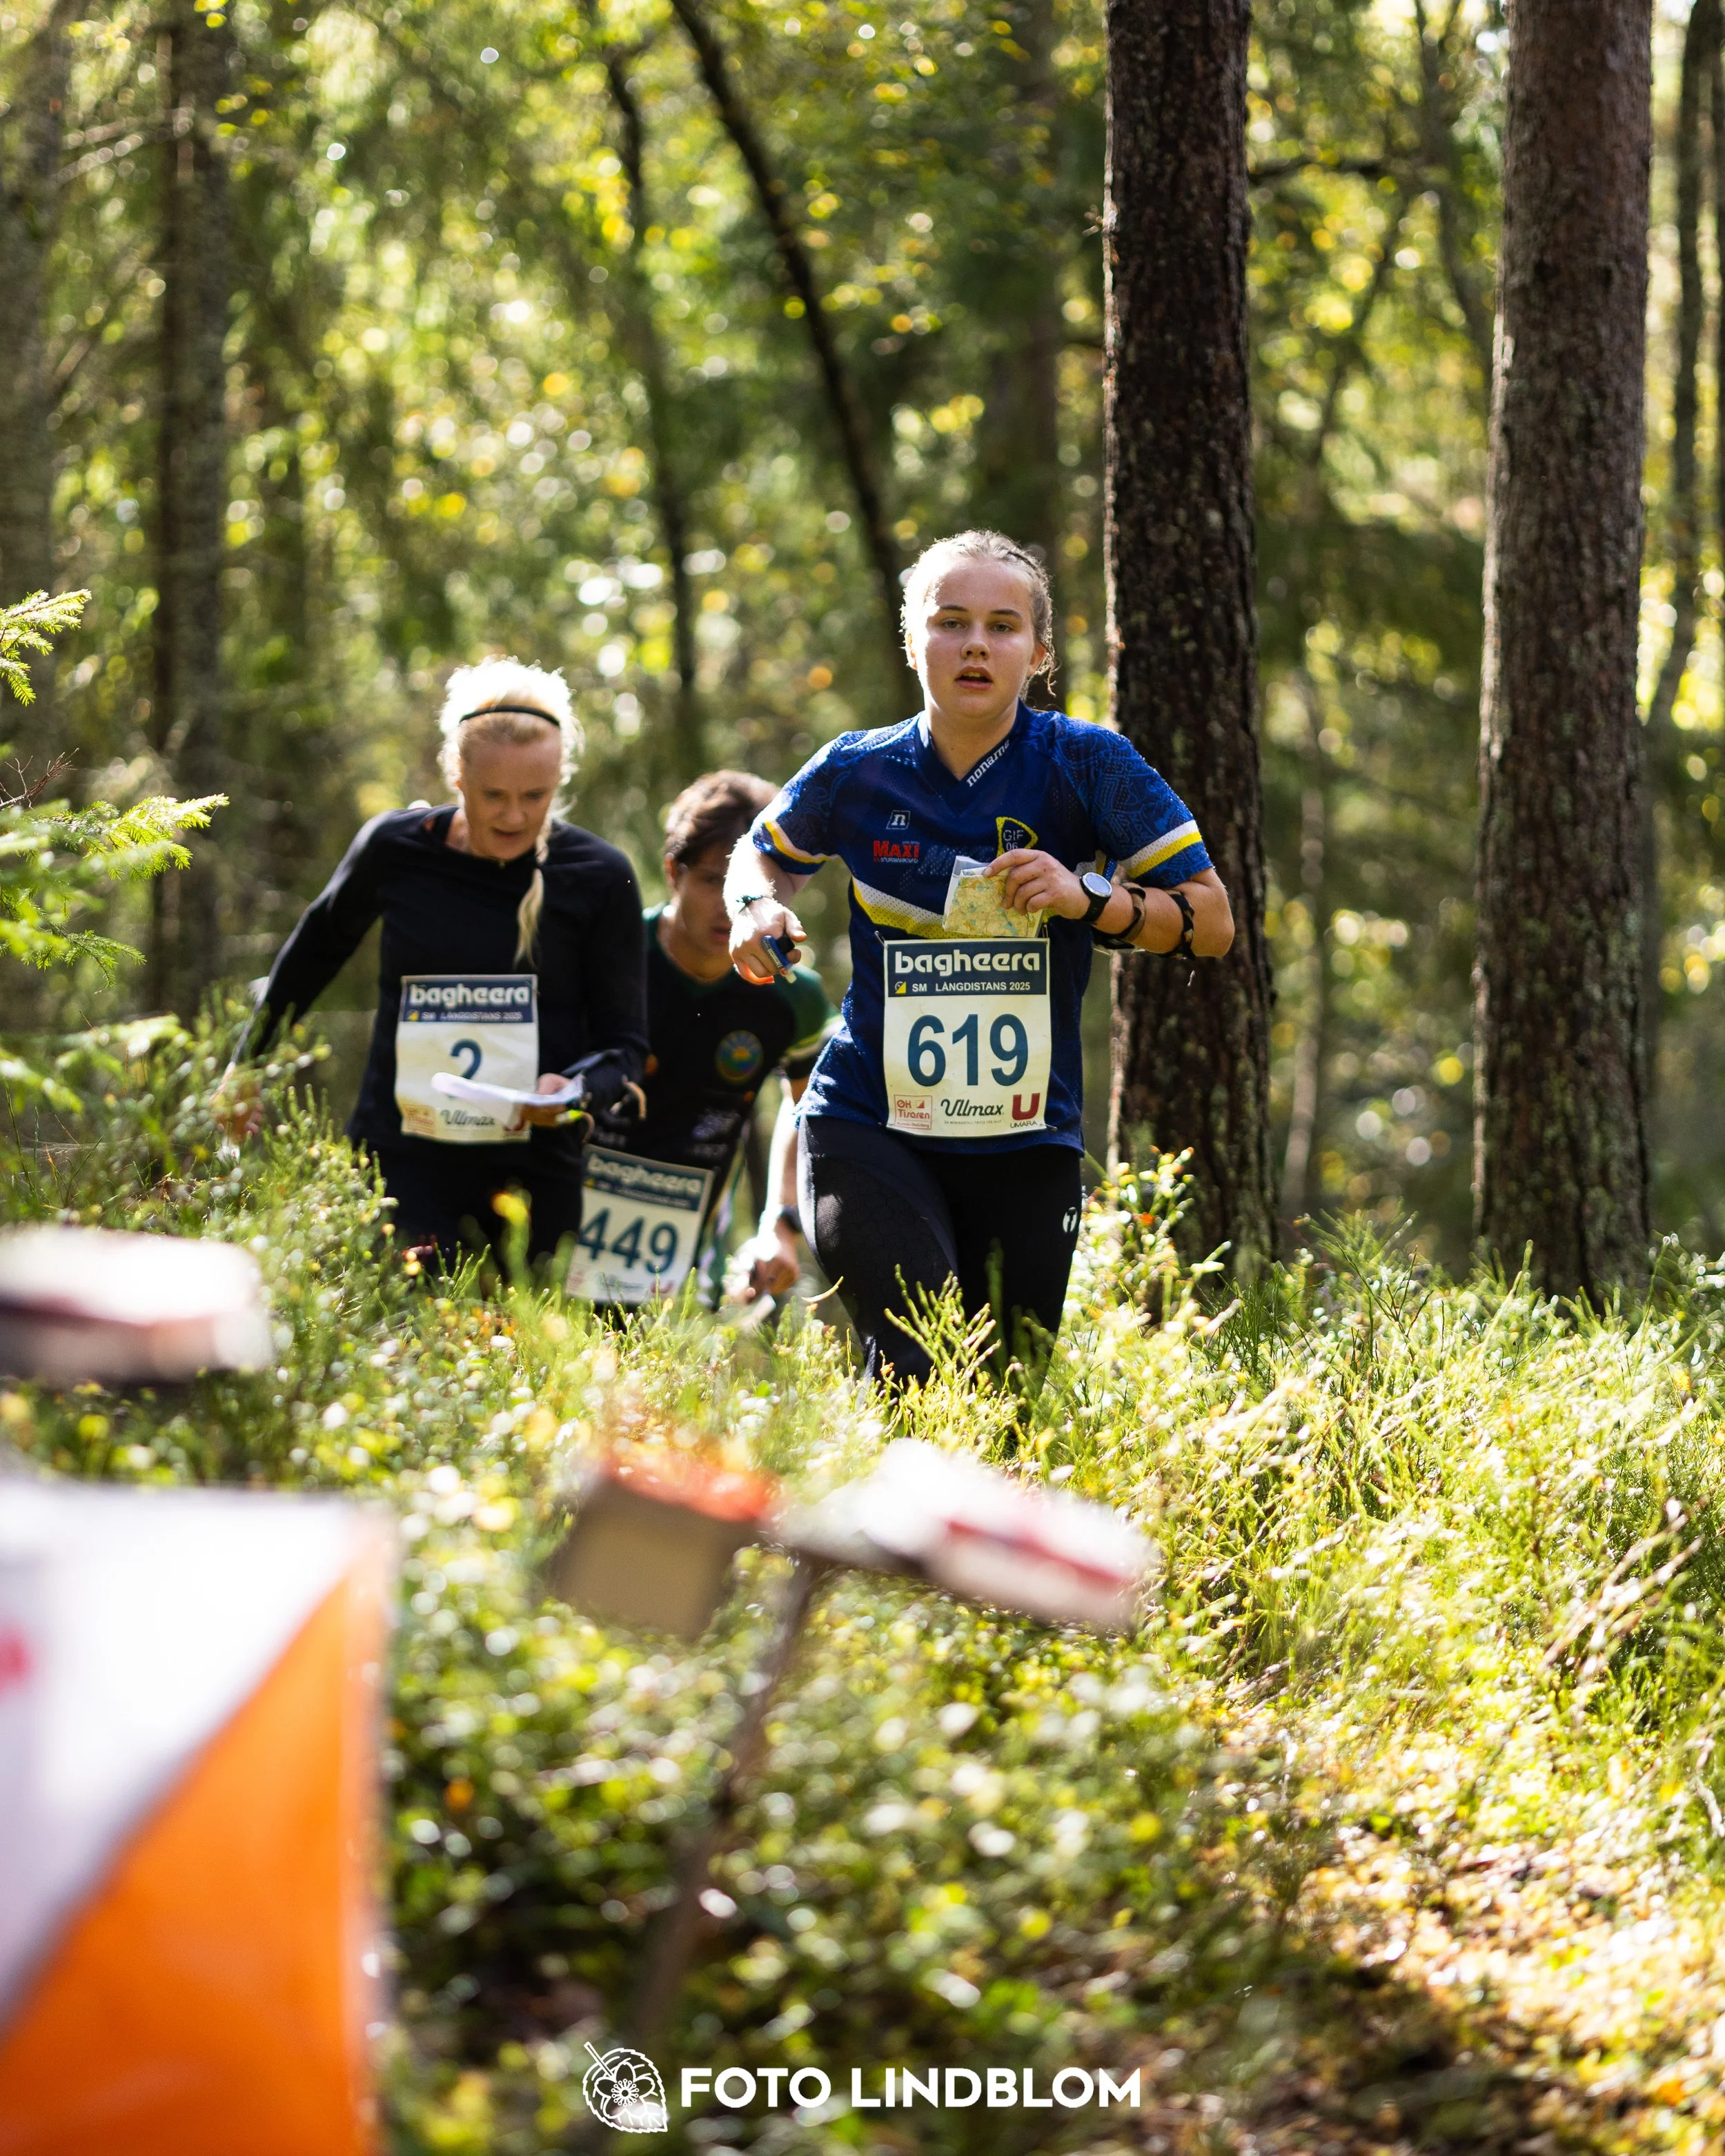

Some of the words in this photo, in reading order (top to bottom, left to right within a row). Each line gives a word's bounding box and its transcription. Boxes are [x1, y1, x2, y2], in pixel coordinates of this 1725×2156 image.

[967, 740, 1009, 787] noname
[1003, 829, 1024, 841] GIF
[874, 840, 920, 858] MAXI
[895, 949, 1041, 976] bagheera
[410, 984, 530, 1009] bagheera
[912, 982, 927, 991] SM
[935, 981, 1007, 991] LÅNGDISTANS
[1009, 982, 1030, 991] 2025
[907, 1013, 1029, 1087] 619
[450, 1038, 482, 1098] 2
[897, 1109, 930, 1120] Tisaren
[940, 1098, 1004, 1117] Ullmax
[1009, 1120, 1038, 1129] UMARA
[588, 1153, 702, 1196] bagheera
[578, 1207, 679, 1274] 449
